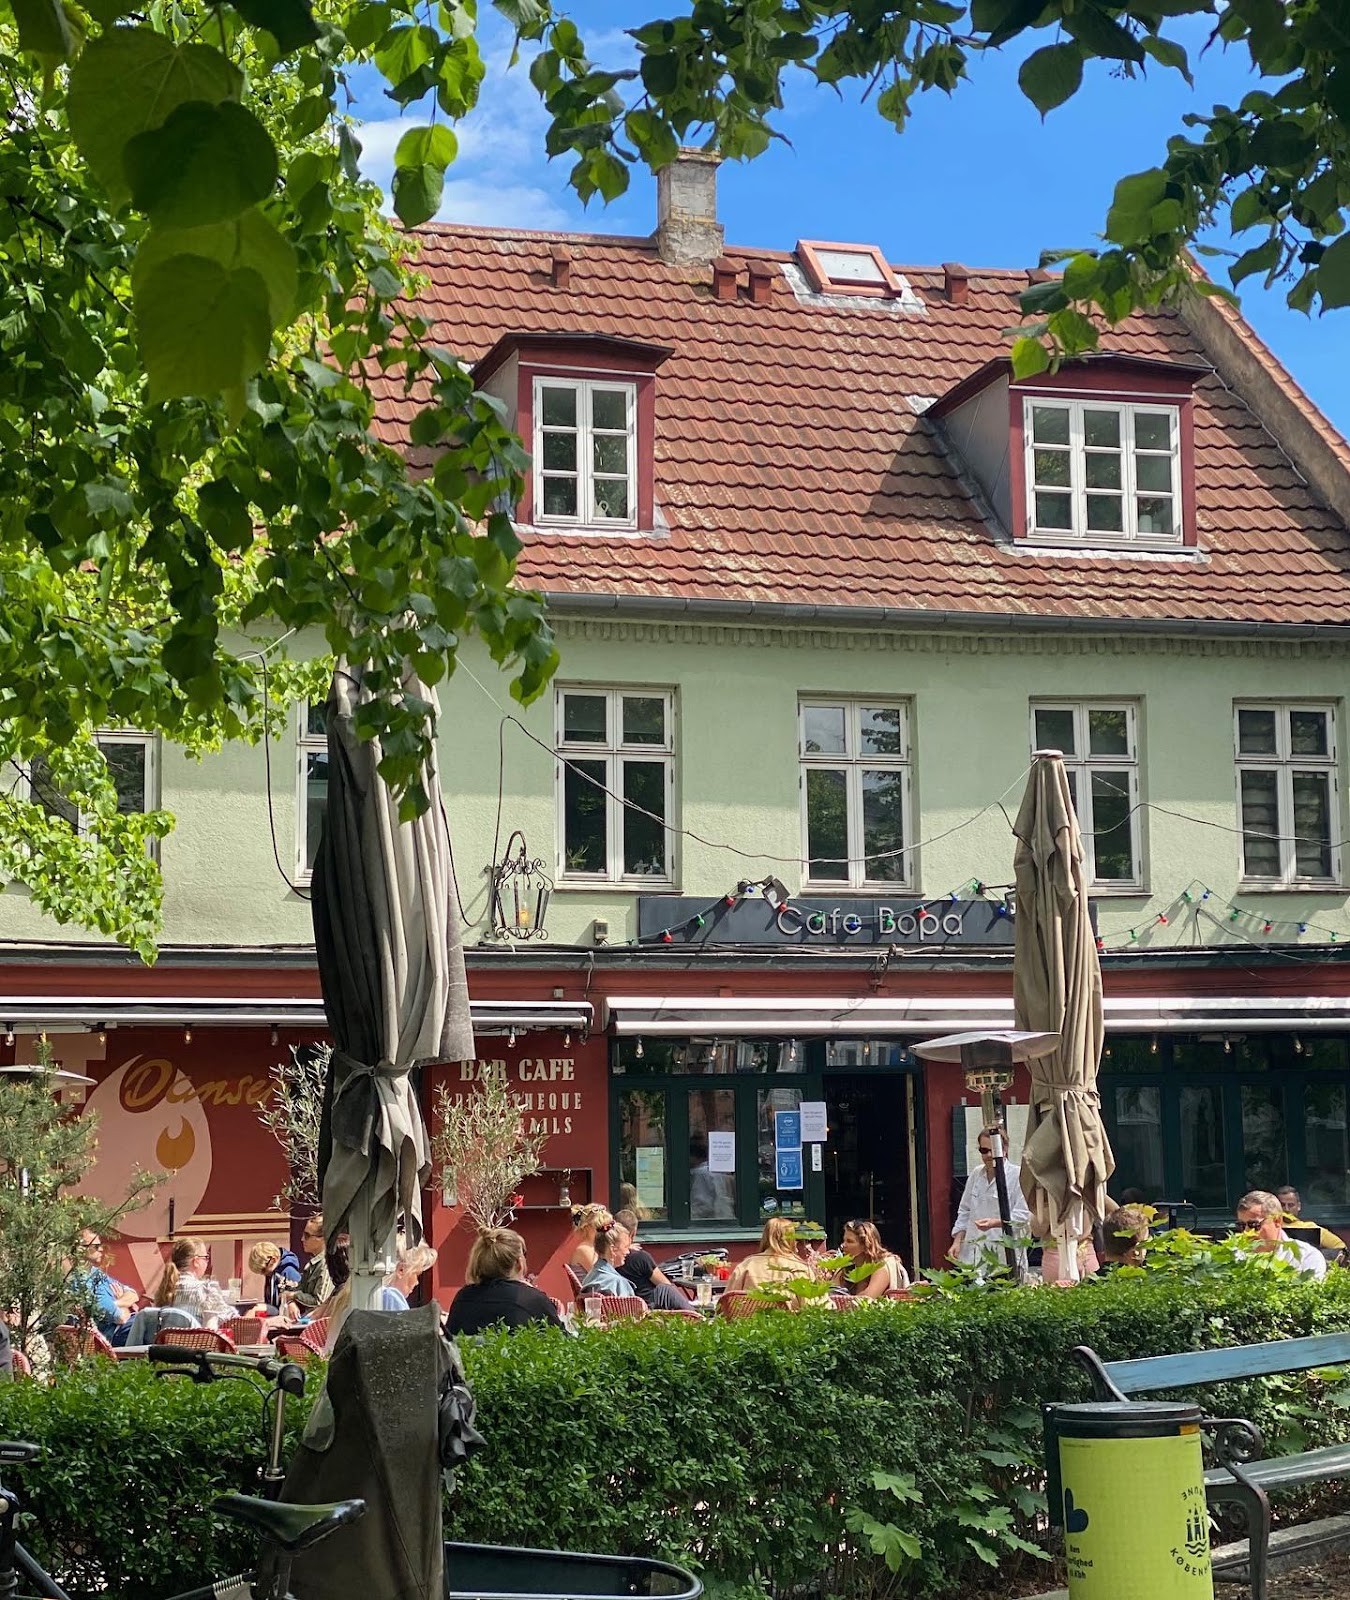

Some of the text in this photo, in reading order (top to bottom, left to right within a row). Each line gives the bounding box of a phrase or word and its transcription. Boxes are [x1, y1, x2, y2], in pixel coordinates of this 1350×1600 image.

[777, 906, 963, 941] Cafe Bopa
[460, 1058, 575, 1082] BAR CAFE
